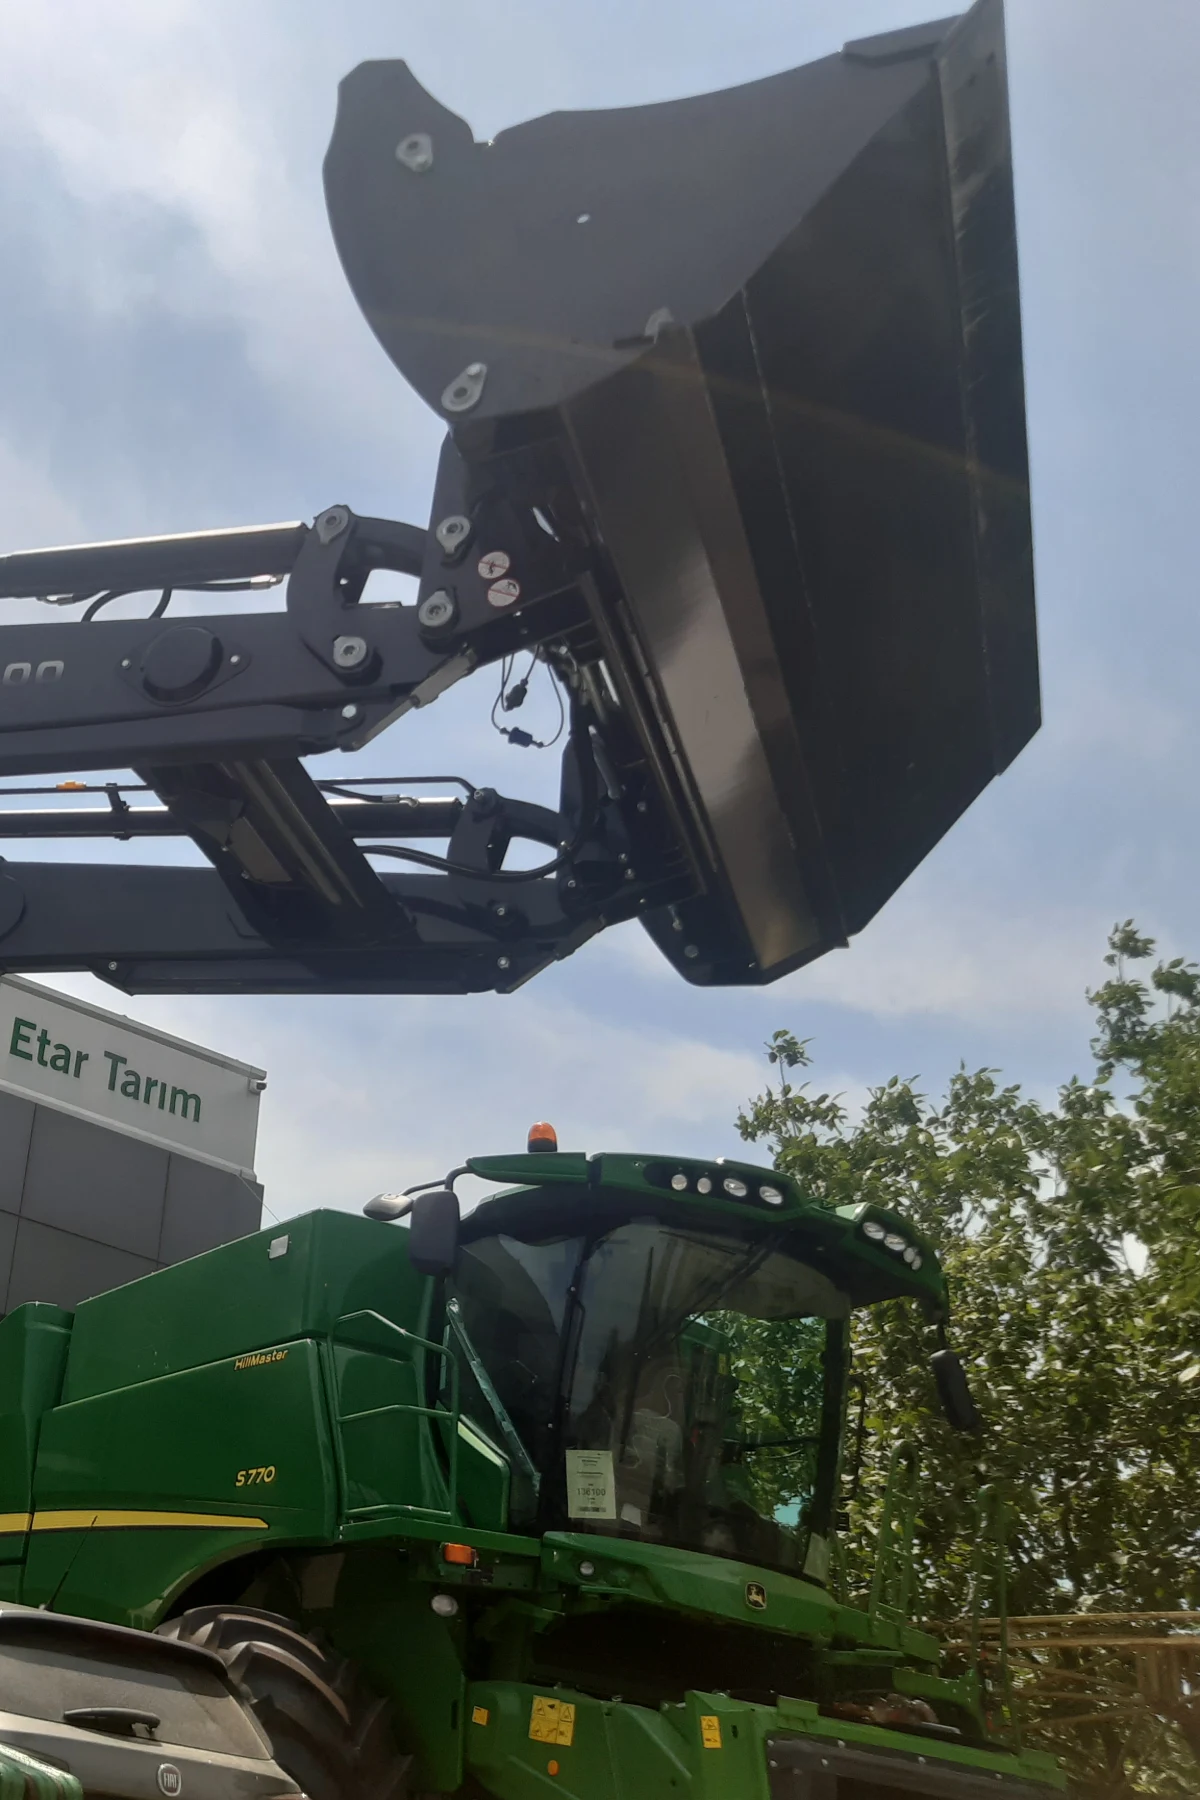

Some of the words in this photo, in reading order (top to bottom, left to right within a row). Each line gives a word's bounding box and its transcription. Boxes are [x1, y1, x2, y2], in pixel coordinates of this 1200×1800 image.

[9, 1016, 90, 1079] Etar
[103, 1050, 202, 1123] Tarım
[234, 1350, 289, 1371] HillMaster
[235, 1465, 276, 1487] S770
[163, 1772, 177, 1789] FIAT
